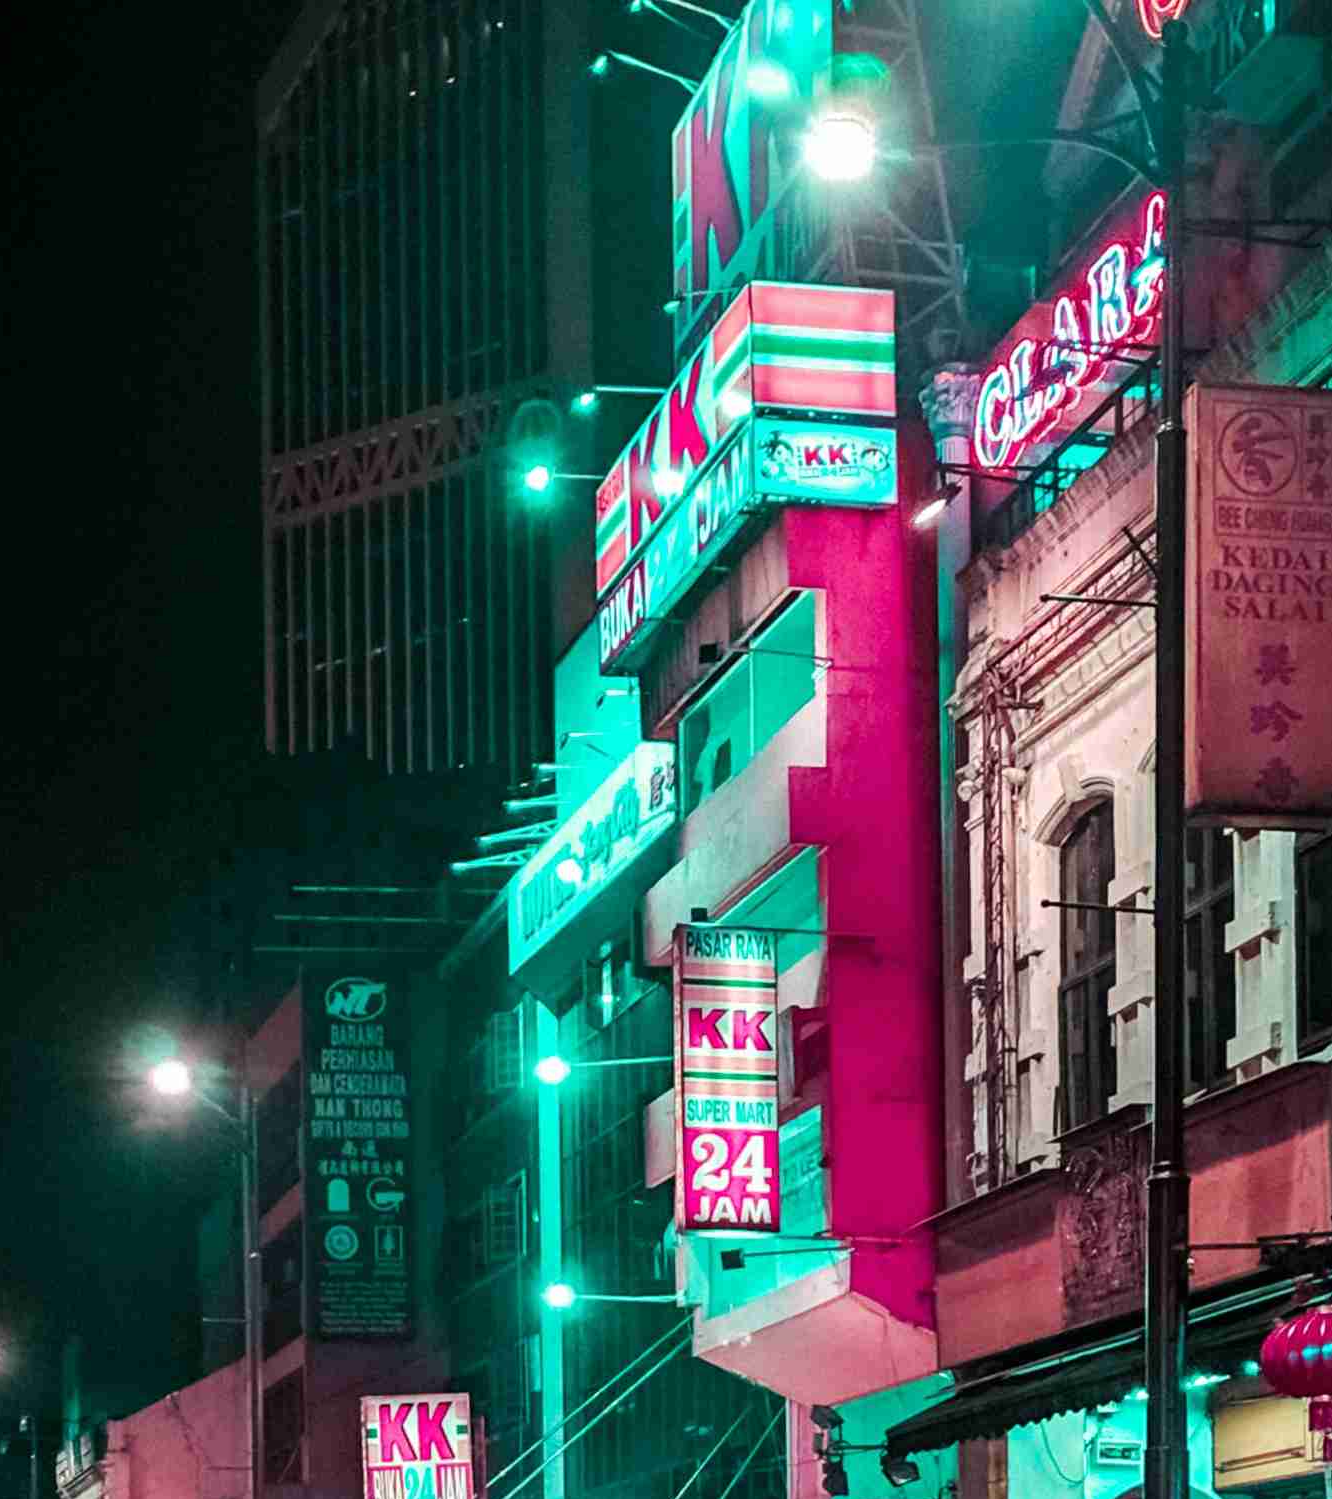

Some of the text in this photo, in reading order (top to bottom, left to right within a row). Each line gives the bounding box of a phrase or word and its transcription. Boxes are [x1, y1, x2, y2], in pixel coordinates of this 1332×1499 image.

[803, 443, 850, 466] KK
[1218, 505, 1242, 530] BEE
[1220, 545, 1330, 571] KEDAI
[599, 562, 647, 668] BUKA
[1223, 596, 1326, 623] SALAI
[686, 931, 772, 960] PASAR RAYA
[688, 1007, 774, 1051] KK
[686, 1099, 774, 1125] SUPER MART
[691, 1132, 773, 1193] 24
[694, 1196, 772, 1225] JAM
[379, 1402, 455, 1462] KK
